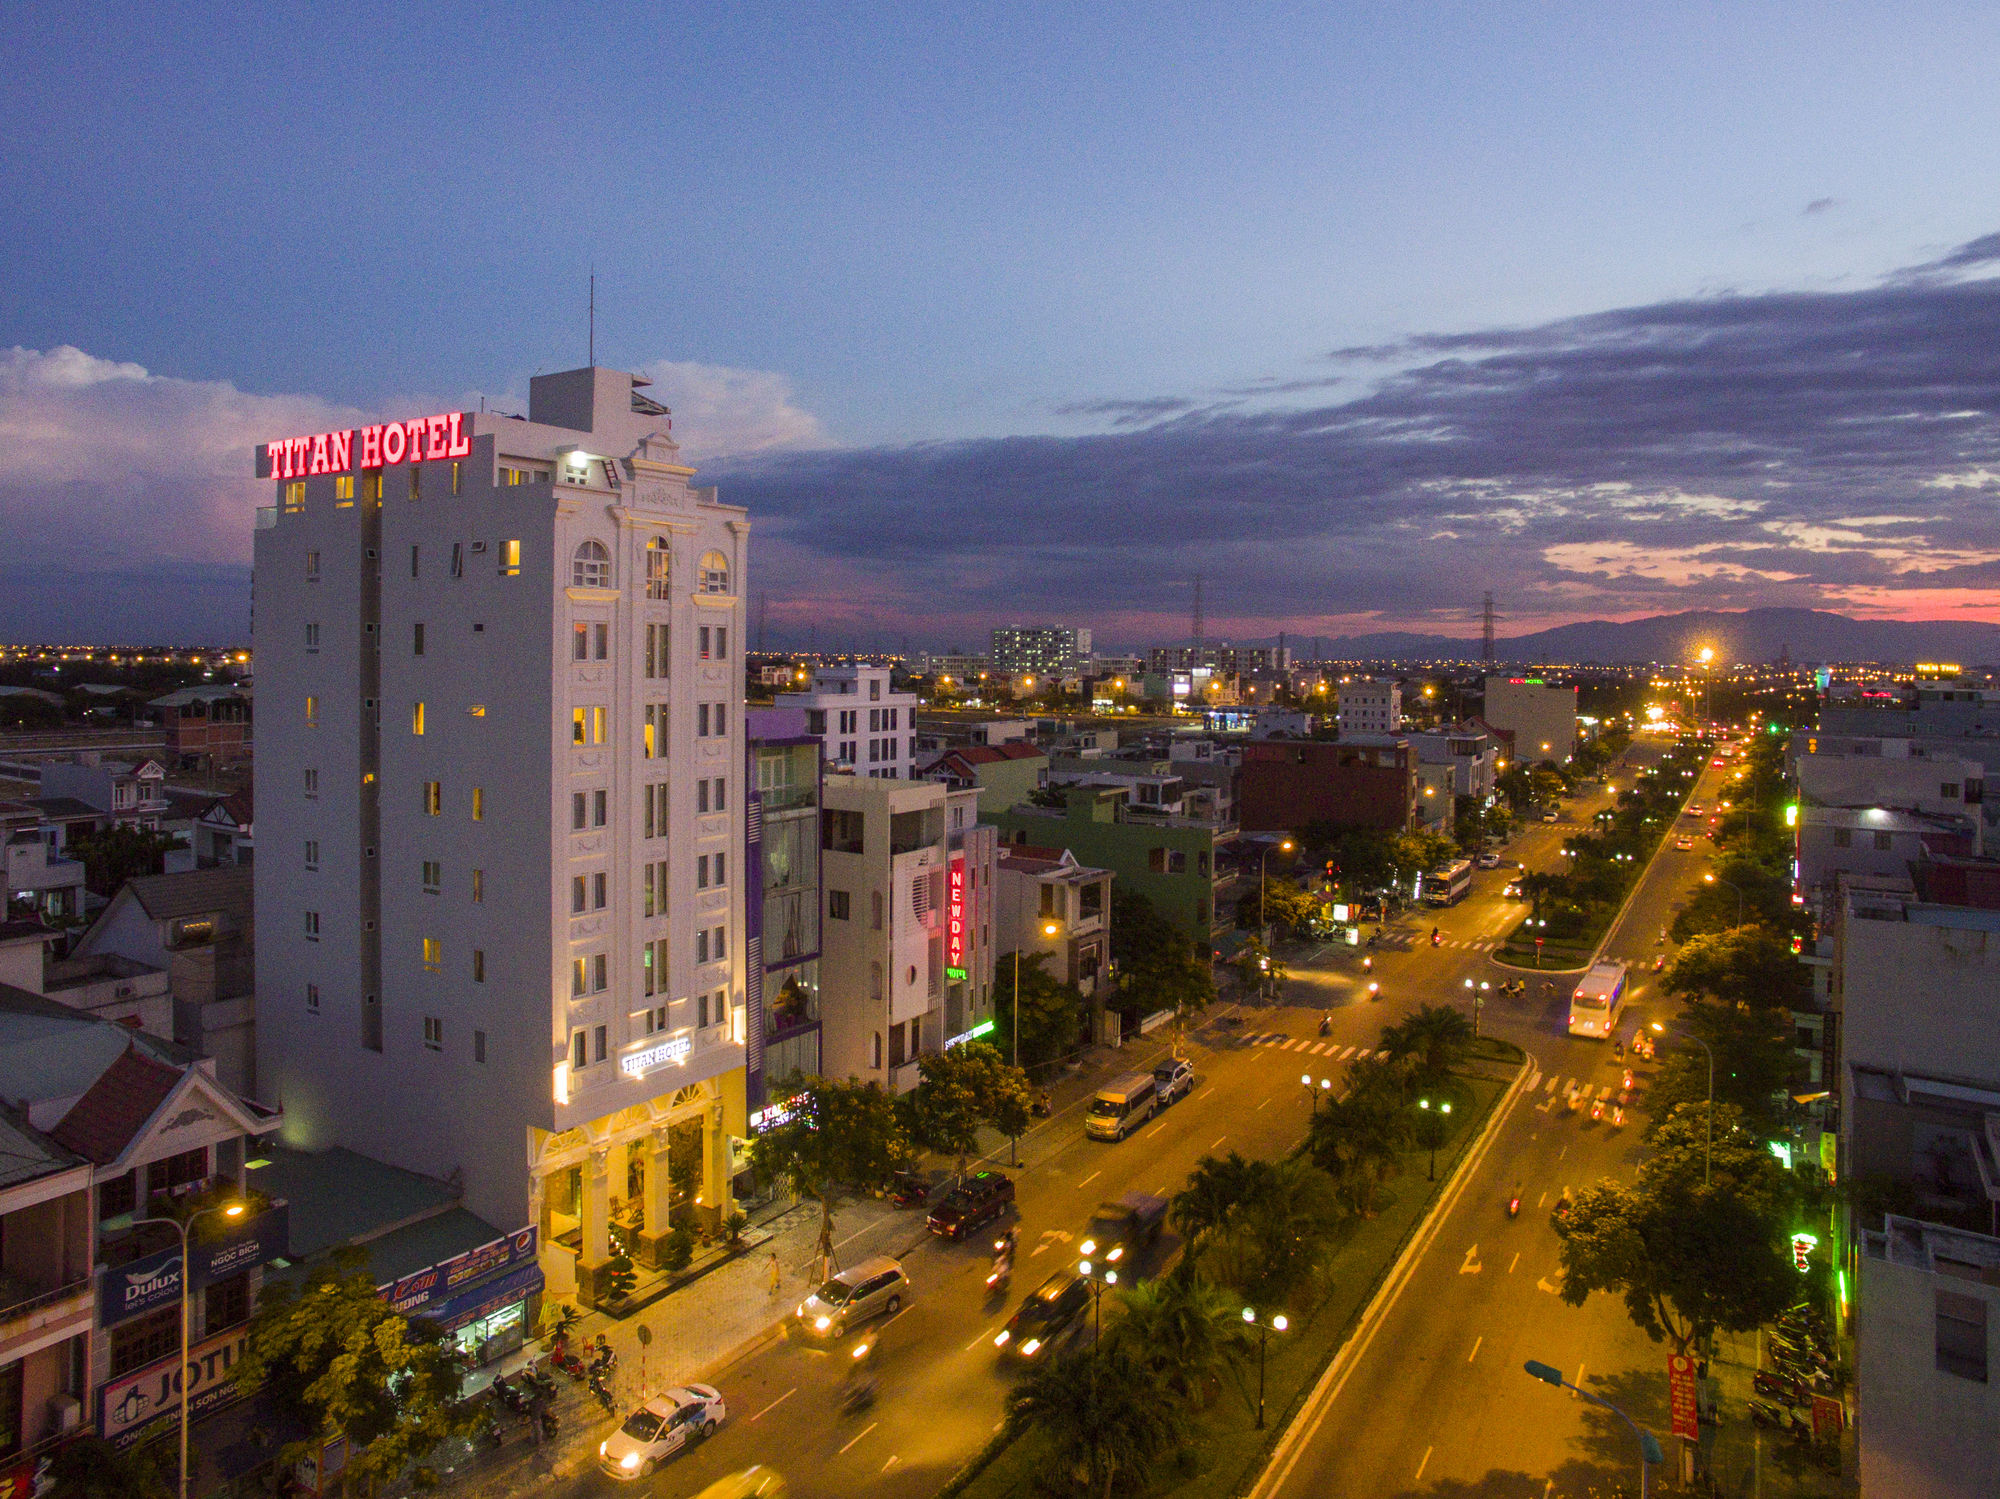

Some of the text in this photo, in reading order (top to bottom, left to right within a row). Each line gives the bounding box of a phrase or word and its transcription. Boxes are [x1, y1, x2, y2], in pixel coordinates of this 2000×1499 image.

[267, 411, 470, 480] TITAN HOTEL
[951, 871, 962, 967] NEWDAY
[946, 967, 967, 980] HOTEL
[625, 1039, 691, 1073] TITAN HOTEL
[210, 1251, 237, 1268] NGỌC
[125, 1270, 180, 1301] Dulux
[125, 1295, 146, 1311] let's
